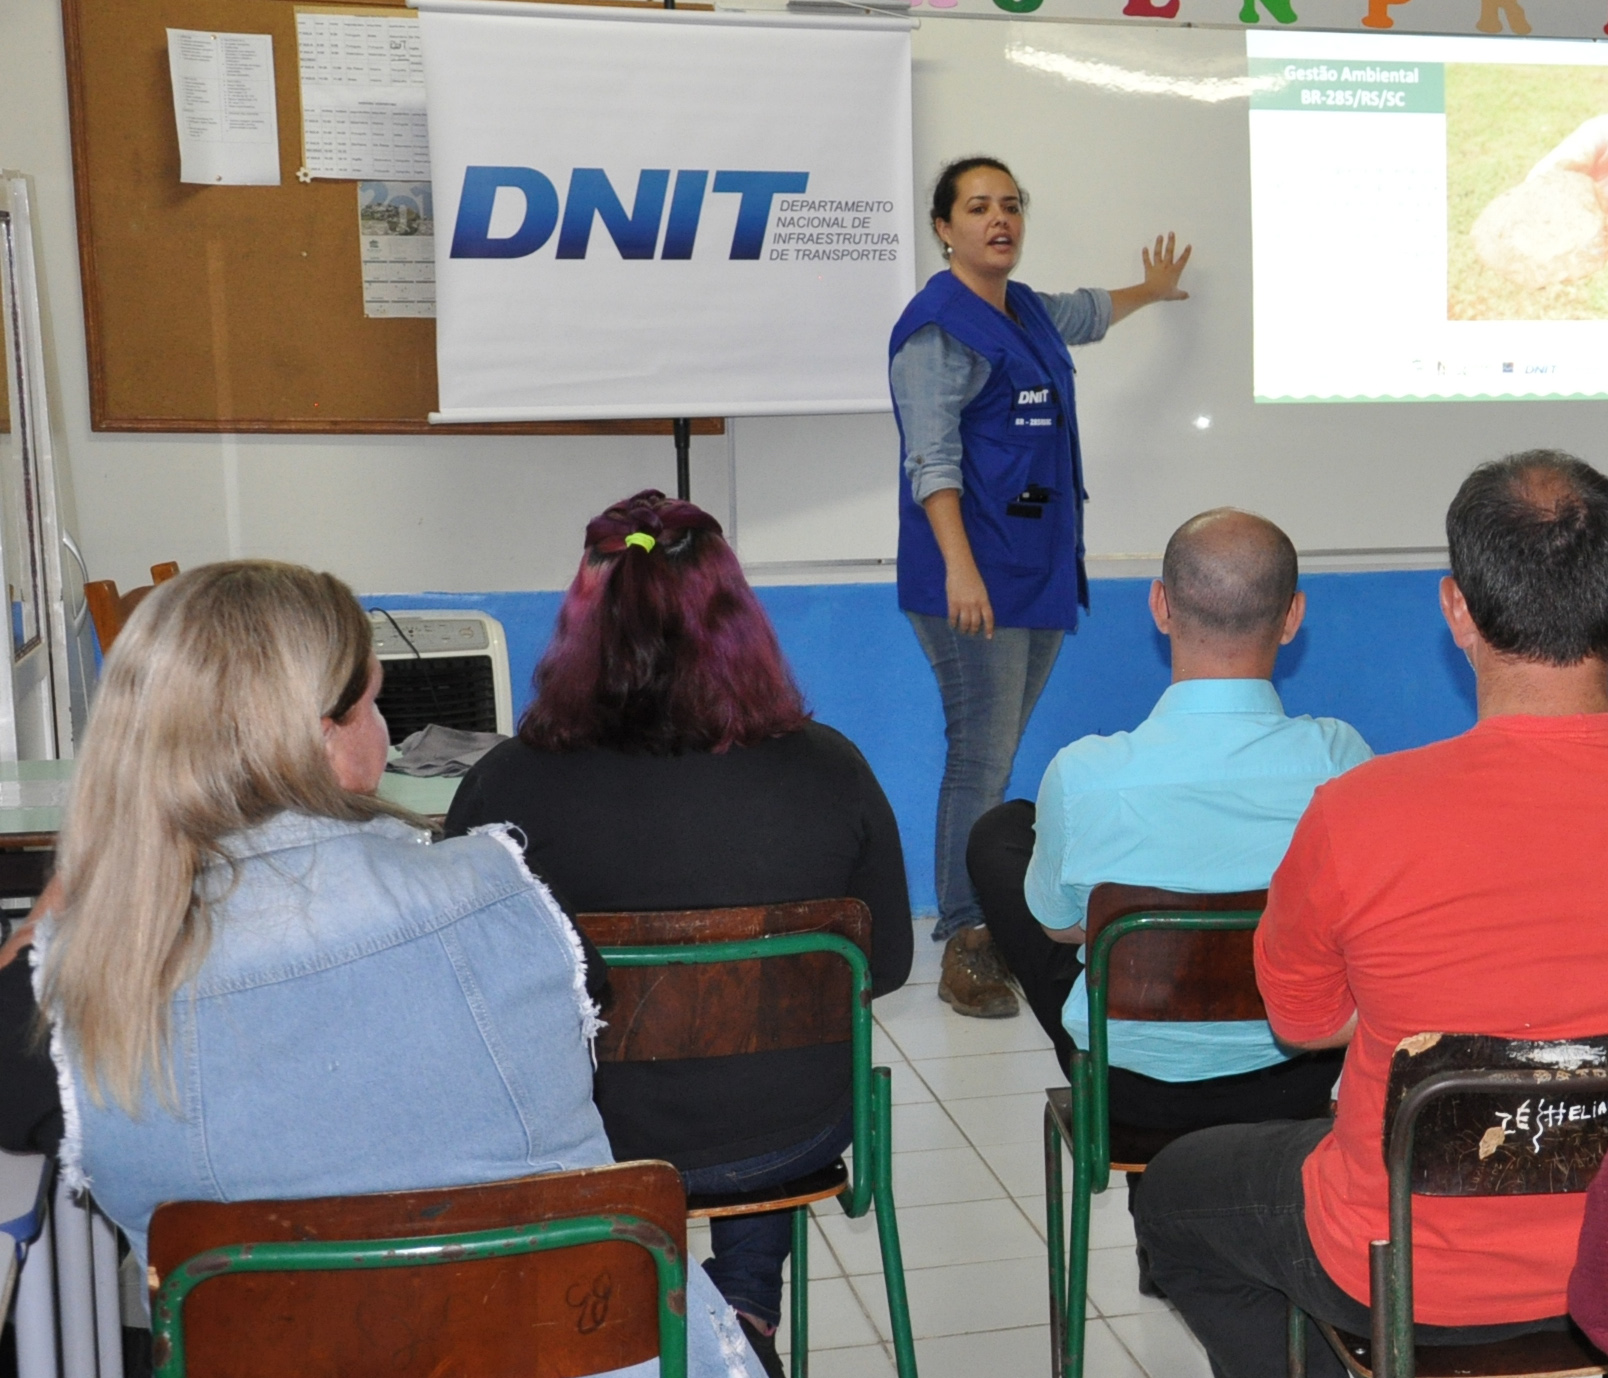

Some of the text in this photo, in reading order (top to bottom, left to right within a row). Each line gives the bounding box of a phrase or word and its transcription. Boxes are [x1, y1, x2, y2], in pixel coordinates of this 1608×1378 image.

[1284, 64, 1420, 84] Gestão Ambiental
[1300, 89, 1406, 109] BR-285/RS/SC
[449, 165, 810, 261] DNIT
[779, 199, 894, 213] DEPARTAMENTO
[776, 216, 872, 229] NACIONAL DE
[772, 232, 900, 245] INFRAESTRUTURA
[769, 249, 897, 261] DE TRANSPORTES
[1018, 389, 1049, 405] DNIT
